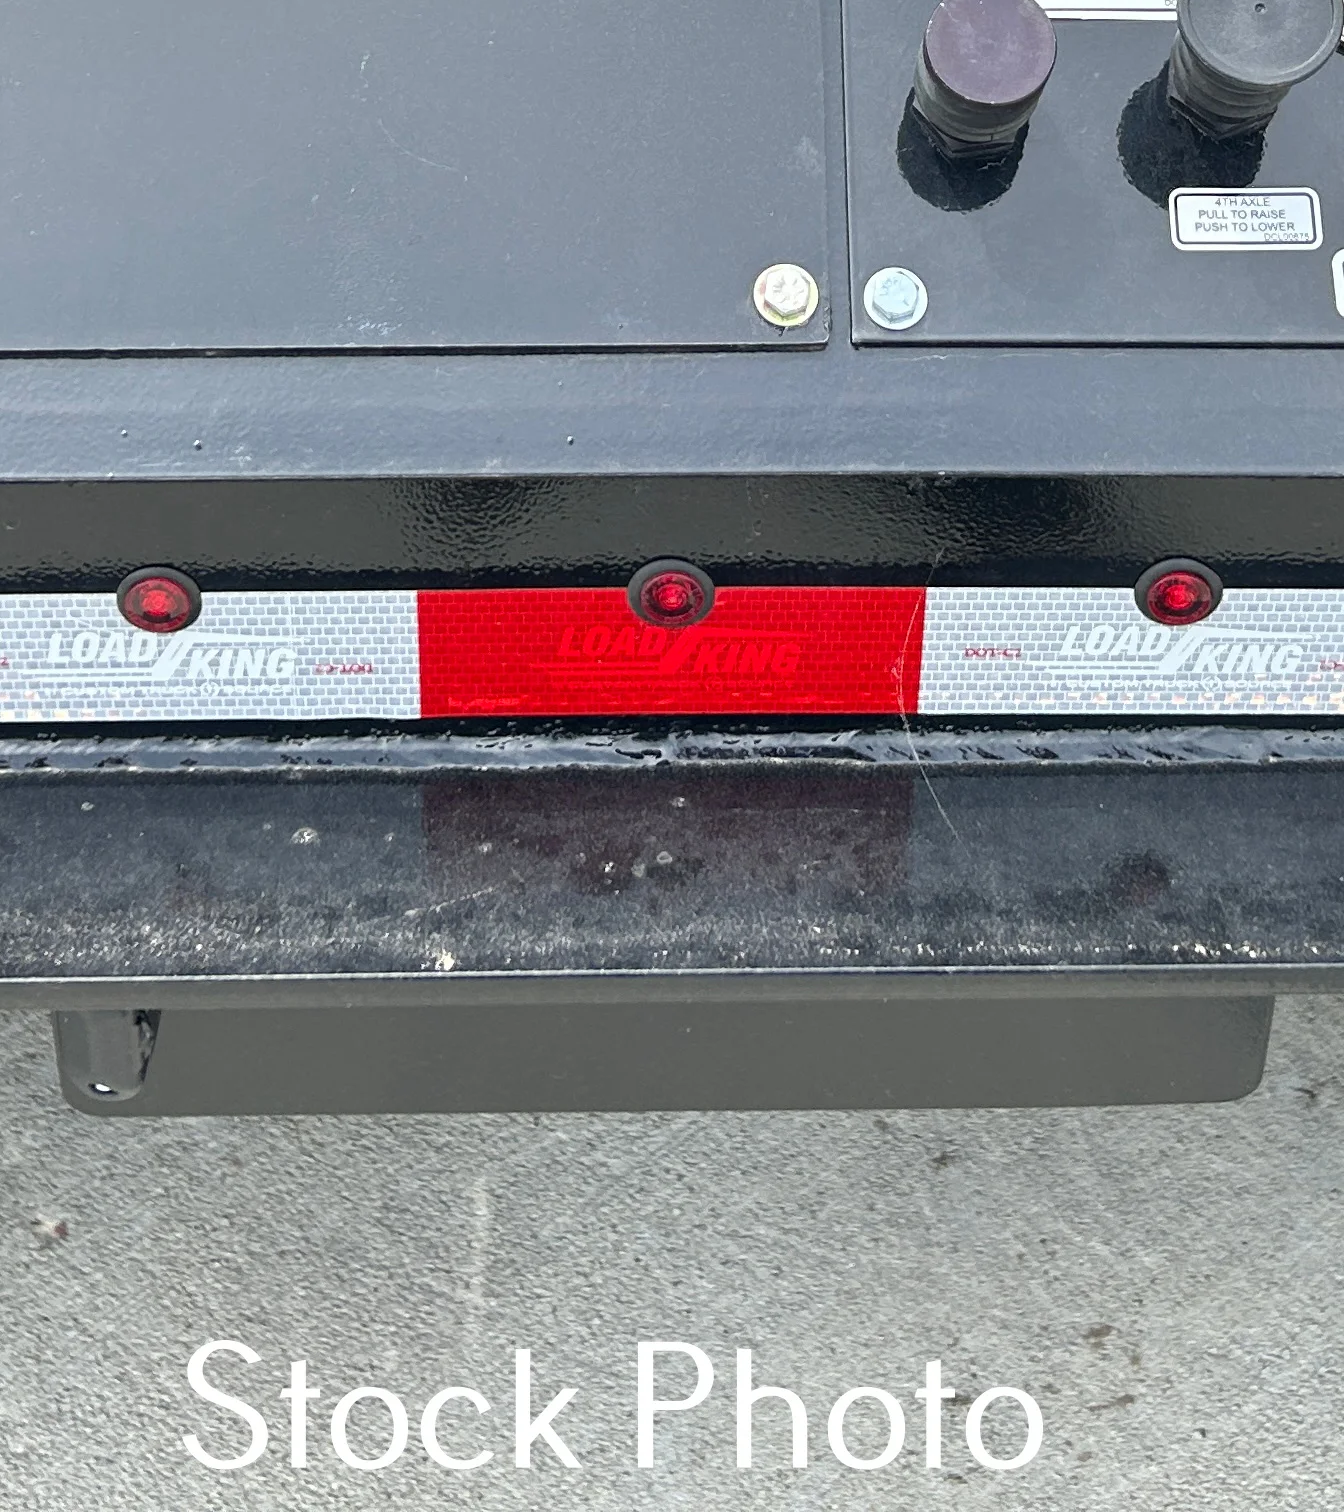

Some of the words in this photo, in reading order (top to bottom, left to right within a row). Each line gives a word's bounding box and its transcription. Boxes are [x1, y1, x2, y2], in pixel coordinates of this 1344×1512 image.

[1198, 210, 1227, 219] PULL
[1231, 210, 1247, 219] TO
[1250, 209, 1286, 219] RAISE
[1215, 197, 1238, 206] 4TH
[1240, 197, 1271, 206] AXLE
[1195, 223, 1228, 232] PUSH
[1232, 223, 1248, 232] TO
[1252, 222, 1295, 231] LOWER
[47, 632, 159, 662] LOAD
[183, 648, 299, 679] KING
[558, 626, 668, 657] LOAD
[693, 643, 800, 673] KING
[1060, 626, 1173, 656] LOAD
[1198, 644, 1305, 675] KING
